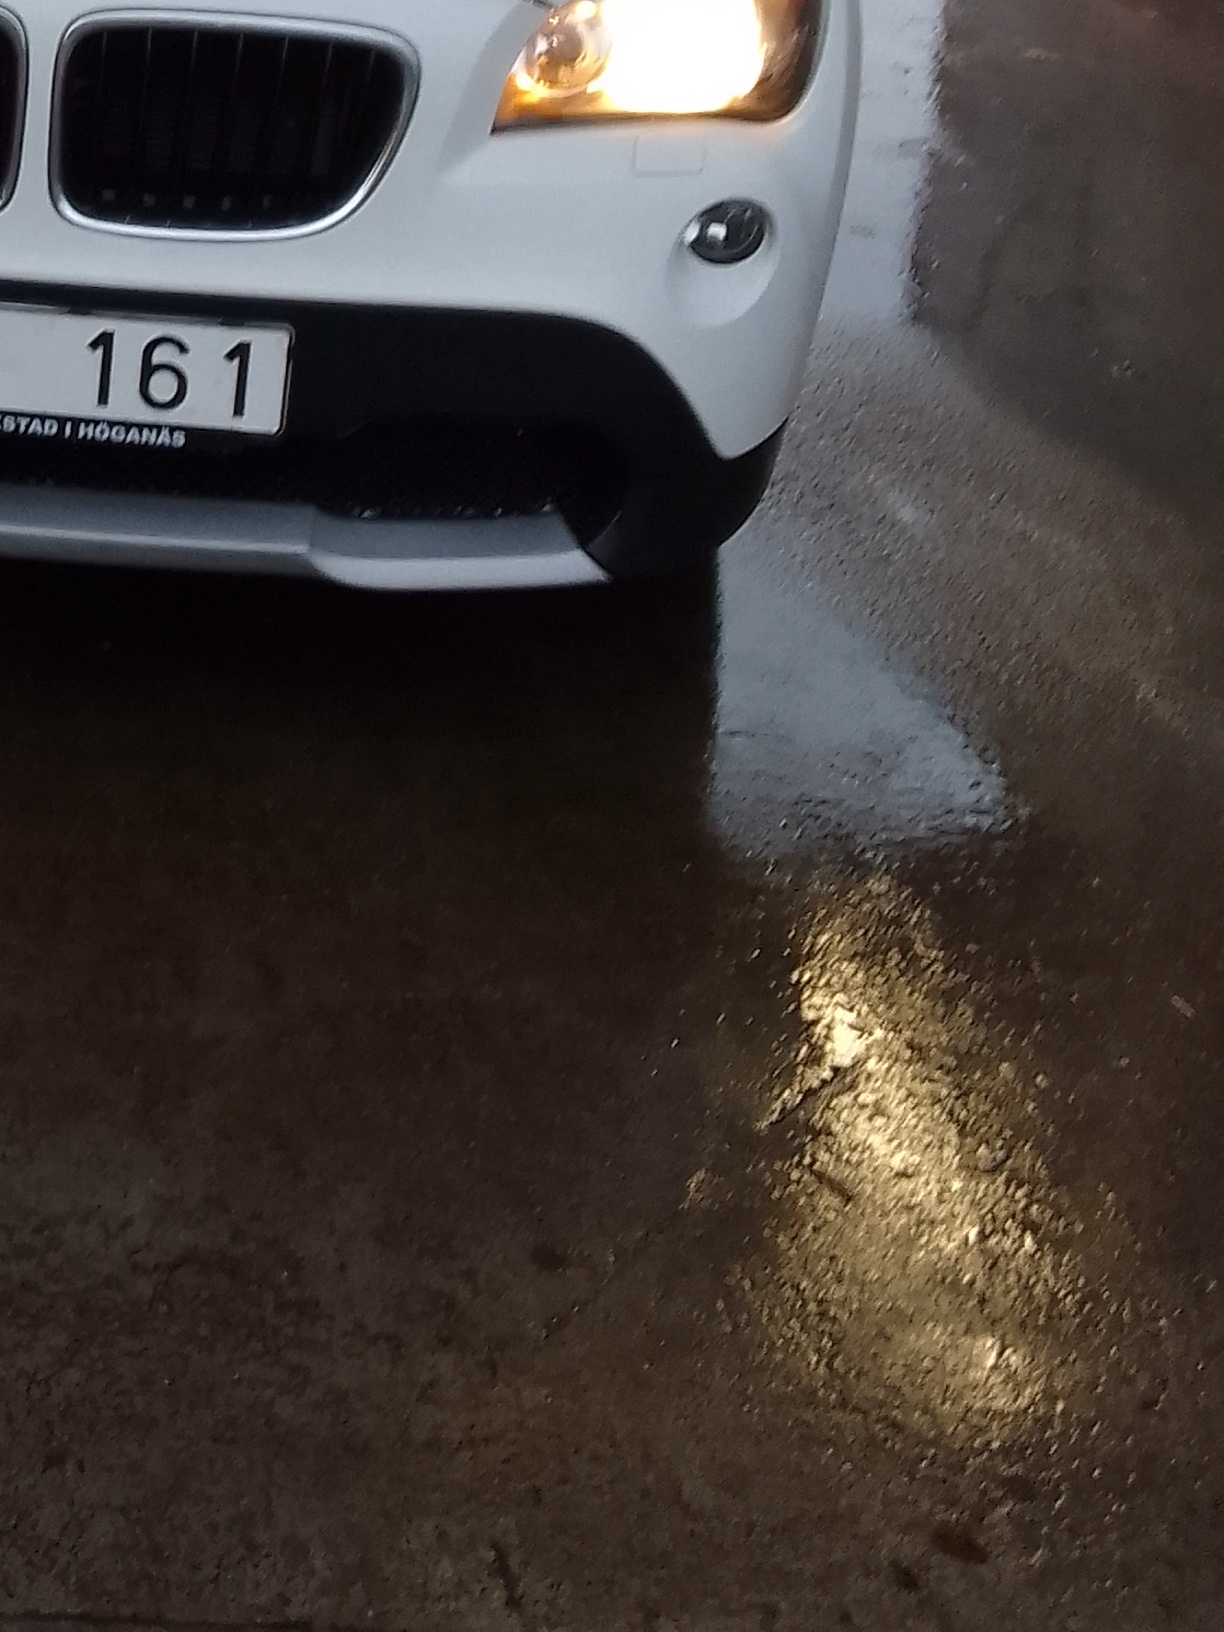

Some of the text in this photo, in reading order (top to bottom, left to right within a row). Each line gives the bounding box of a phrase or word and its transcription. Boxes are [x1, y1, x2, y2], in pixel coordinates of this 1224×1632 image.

[85, 328, 253, 419] 161
[64, 420, 73, 439] I
[77, 420, 187, 449] HÖGANÄS
